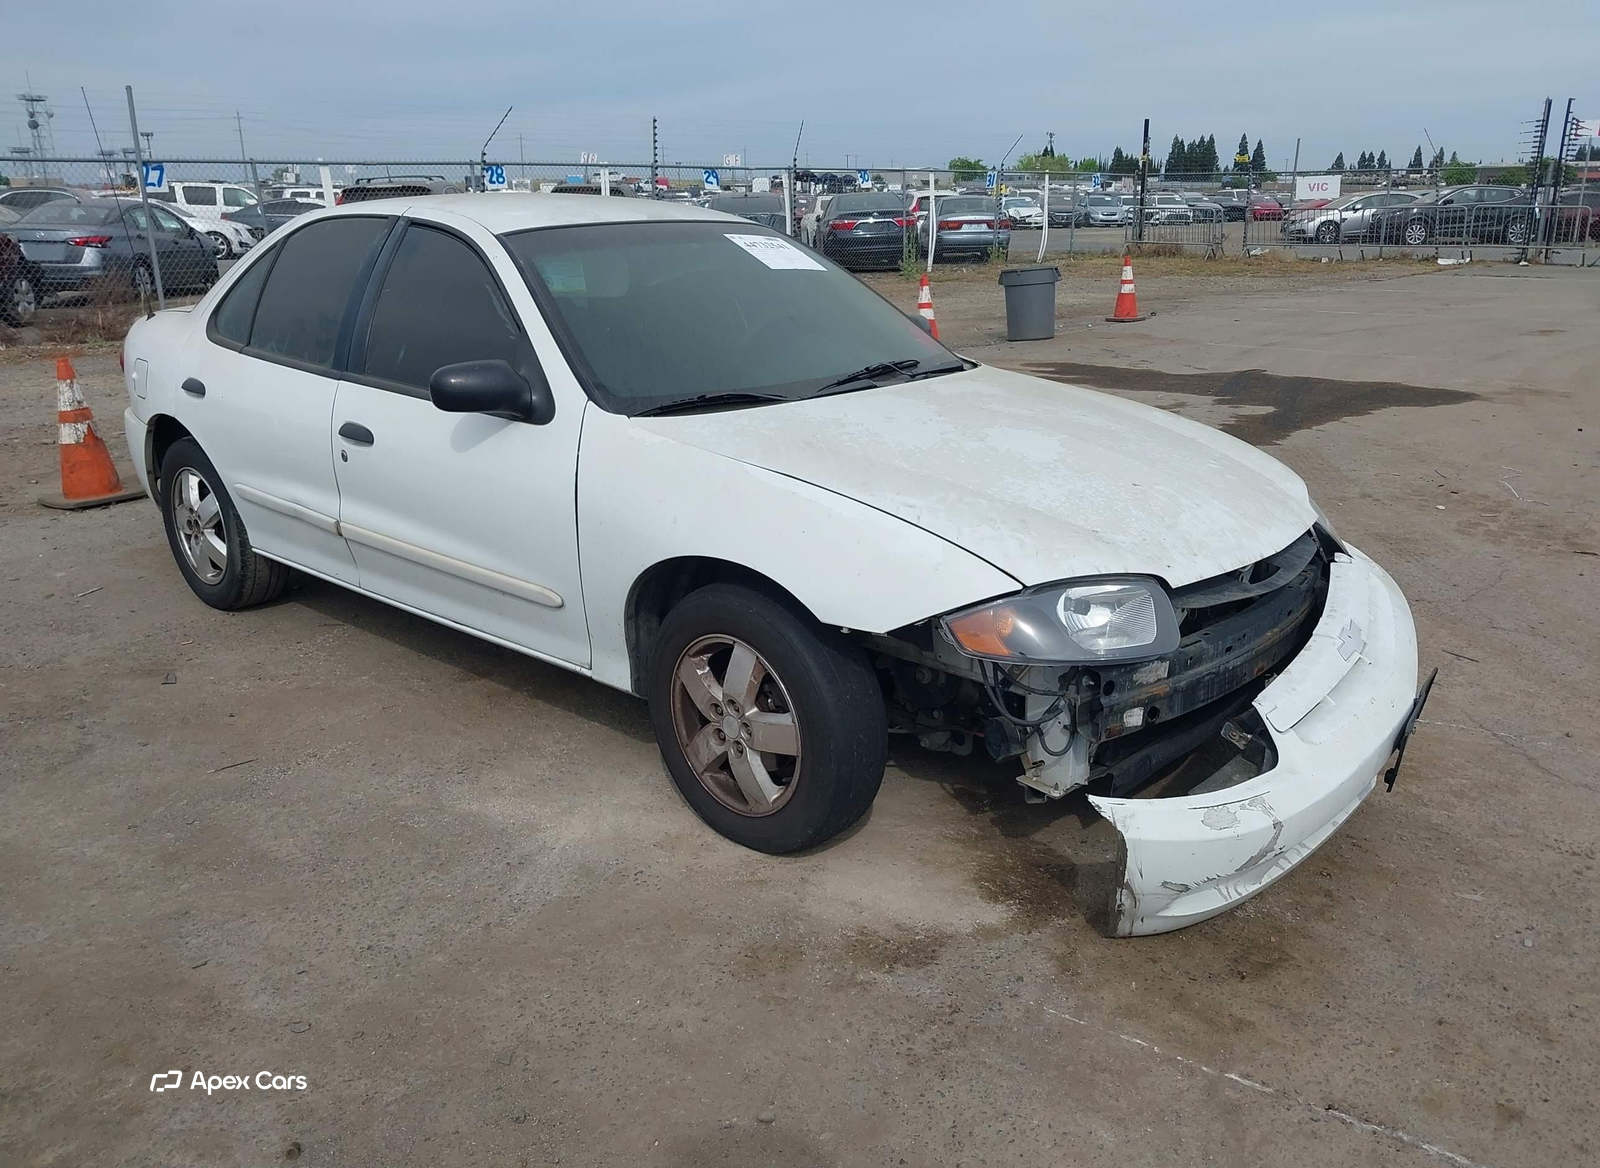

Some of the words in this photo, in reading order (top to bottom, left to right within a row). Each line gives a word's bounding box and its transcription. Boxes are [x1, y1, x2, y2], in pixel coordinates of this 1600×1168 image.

[142, 163, 165, 188] 27
[485, 165, 505, 185] 28
[704, 169, 720, 187] 29
[858, 170, 870, 184] 30
[986, 174, 996, 188] 31
[1308, 182, 1329, 192] VIC
